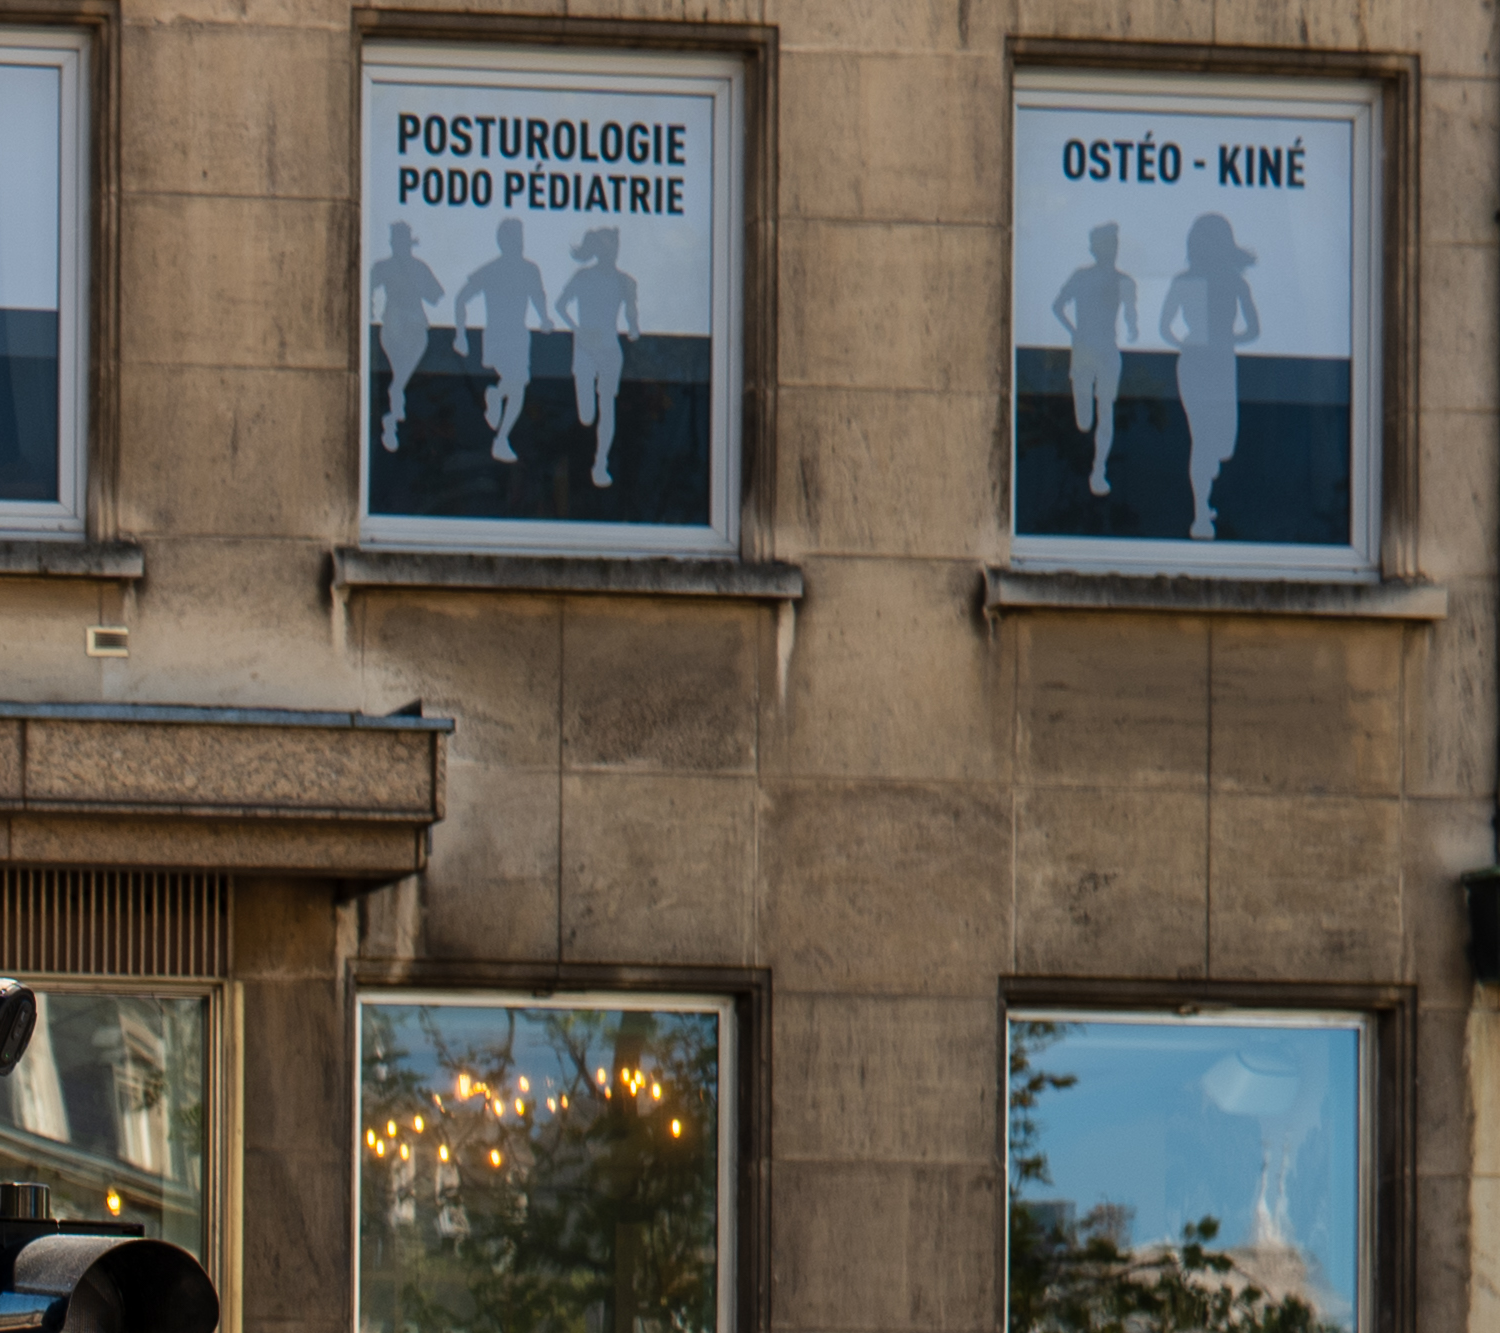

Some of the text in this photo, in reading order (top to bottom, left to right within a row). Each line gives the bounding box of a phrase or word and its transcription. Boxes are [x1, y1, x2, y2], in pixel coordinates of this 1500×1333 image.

[395, 110, 688, 168] POSTUROLOGIE
[1062, 132, 1179, 190] OSTÉO
[1218, 134, 1306, 190] KINÉ
[397, 158, 685, 217] PODO PÉDIATRIE
